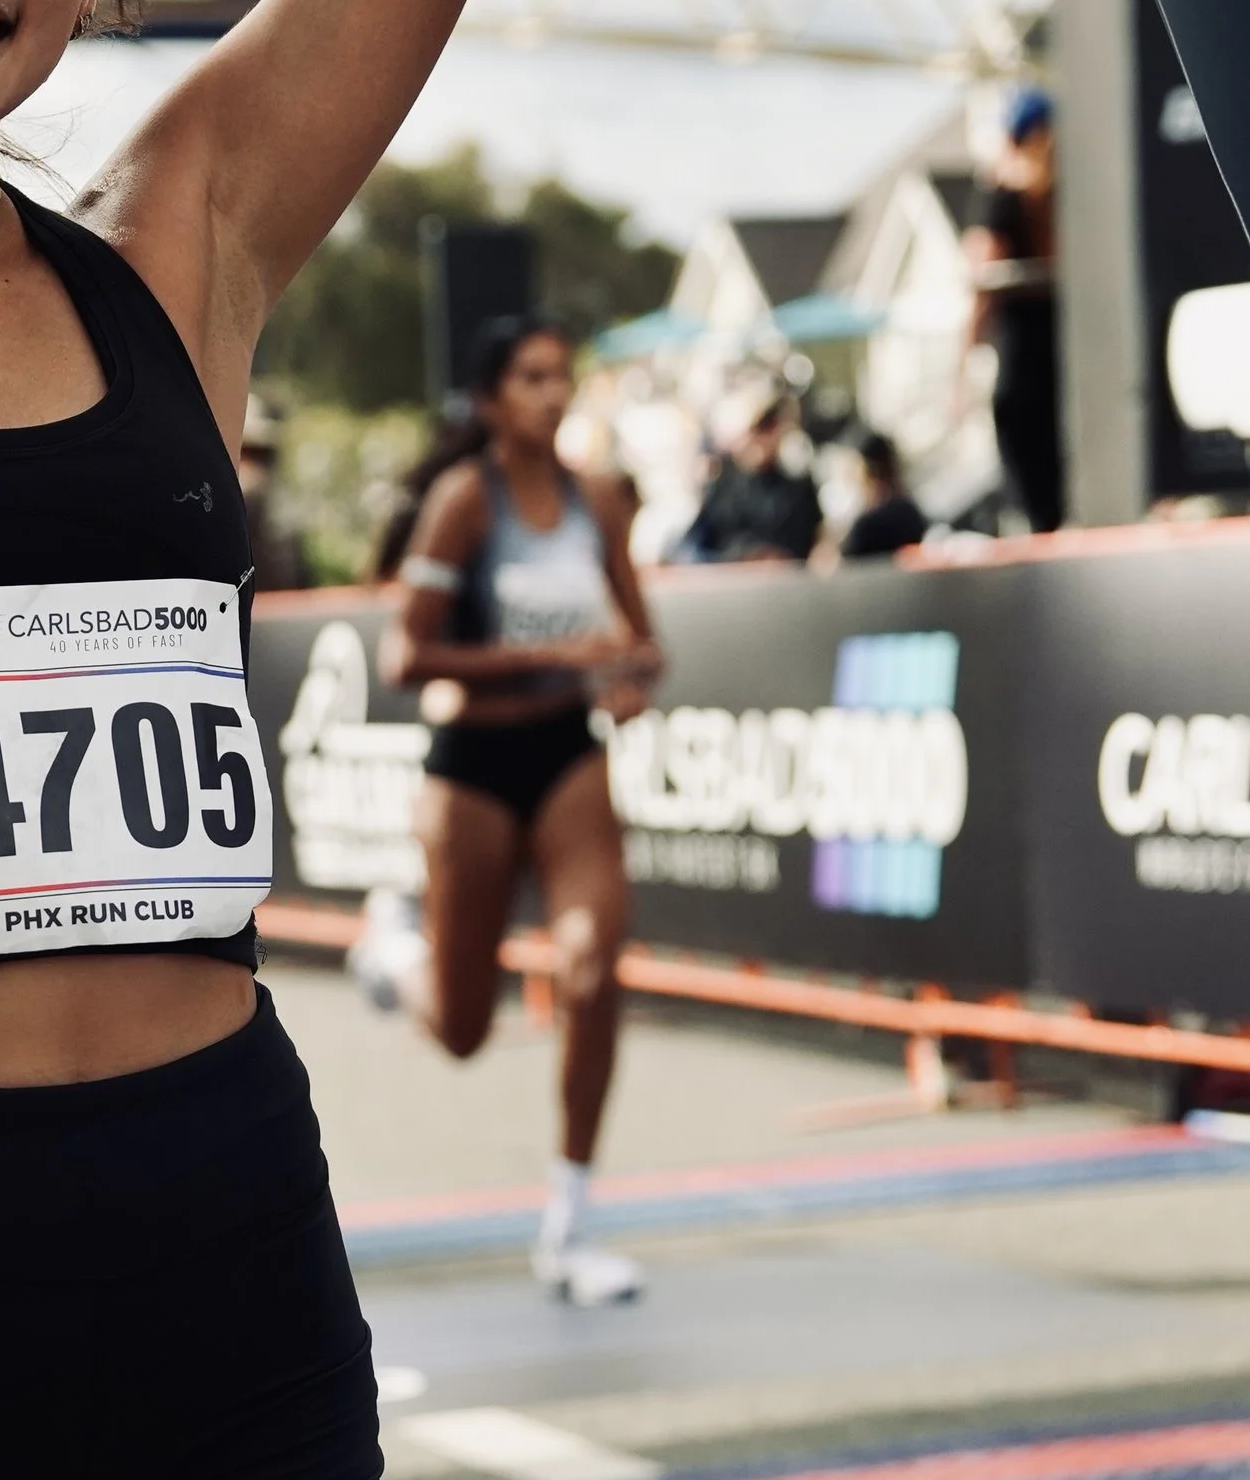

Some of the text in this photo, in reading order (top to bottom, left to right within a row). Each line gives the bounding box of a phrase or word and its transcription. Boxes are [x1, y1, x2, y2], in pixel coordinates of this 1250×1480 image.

[7, 606, 208, 638] CARLSBAD5000
[49, 633, 184, 653] 40 YEARS OF FAST
[4, 899, 195, 932] PHX RUN CLUB
